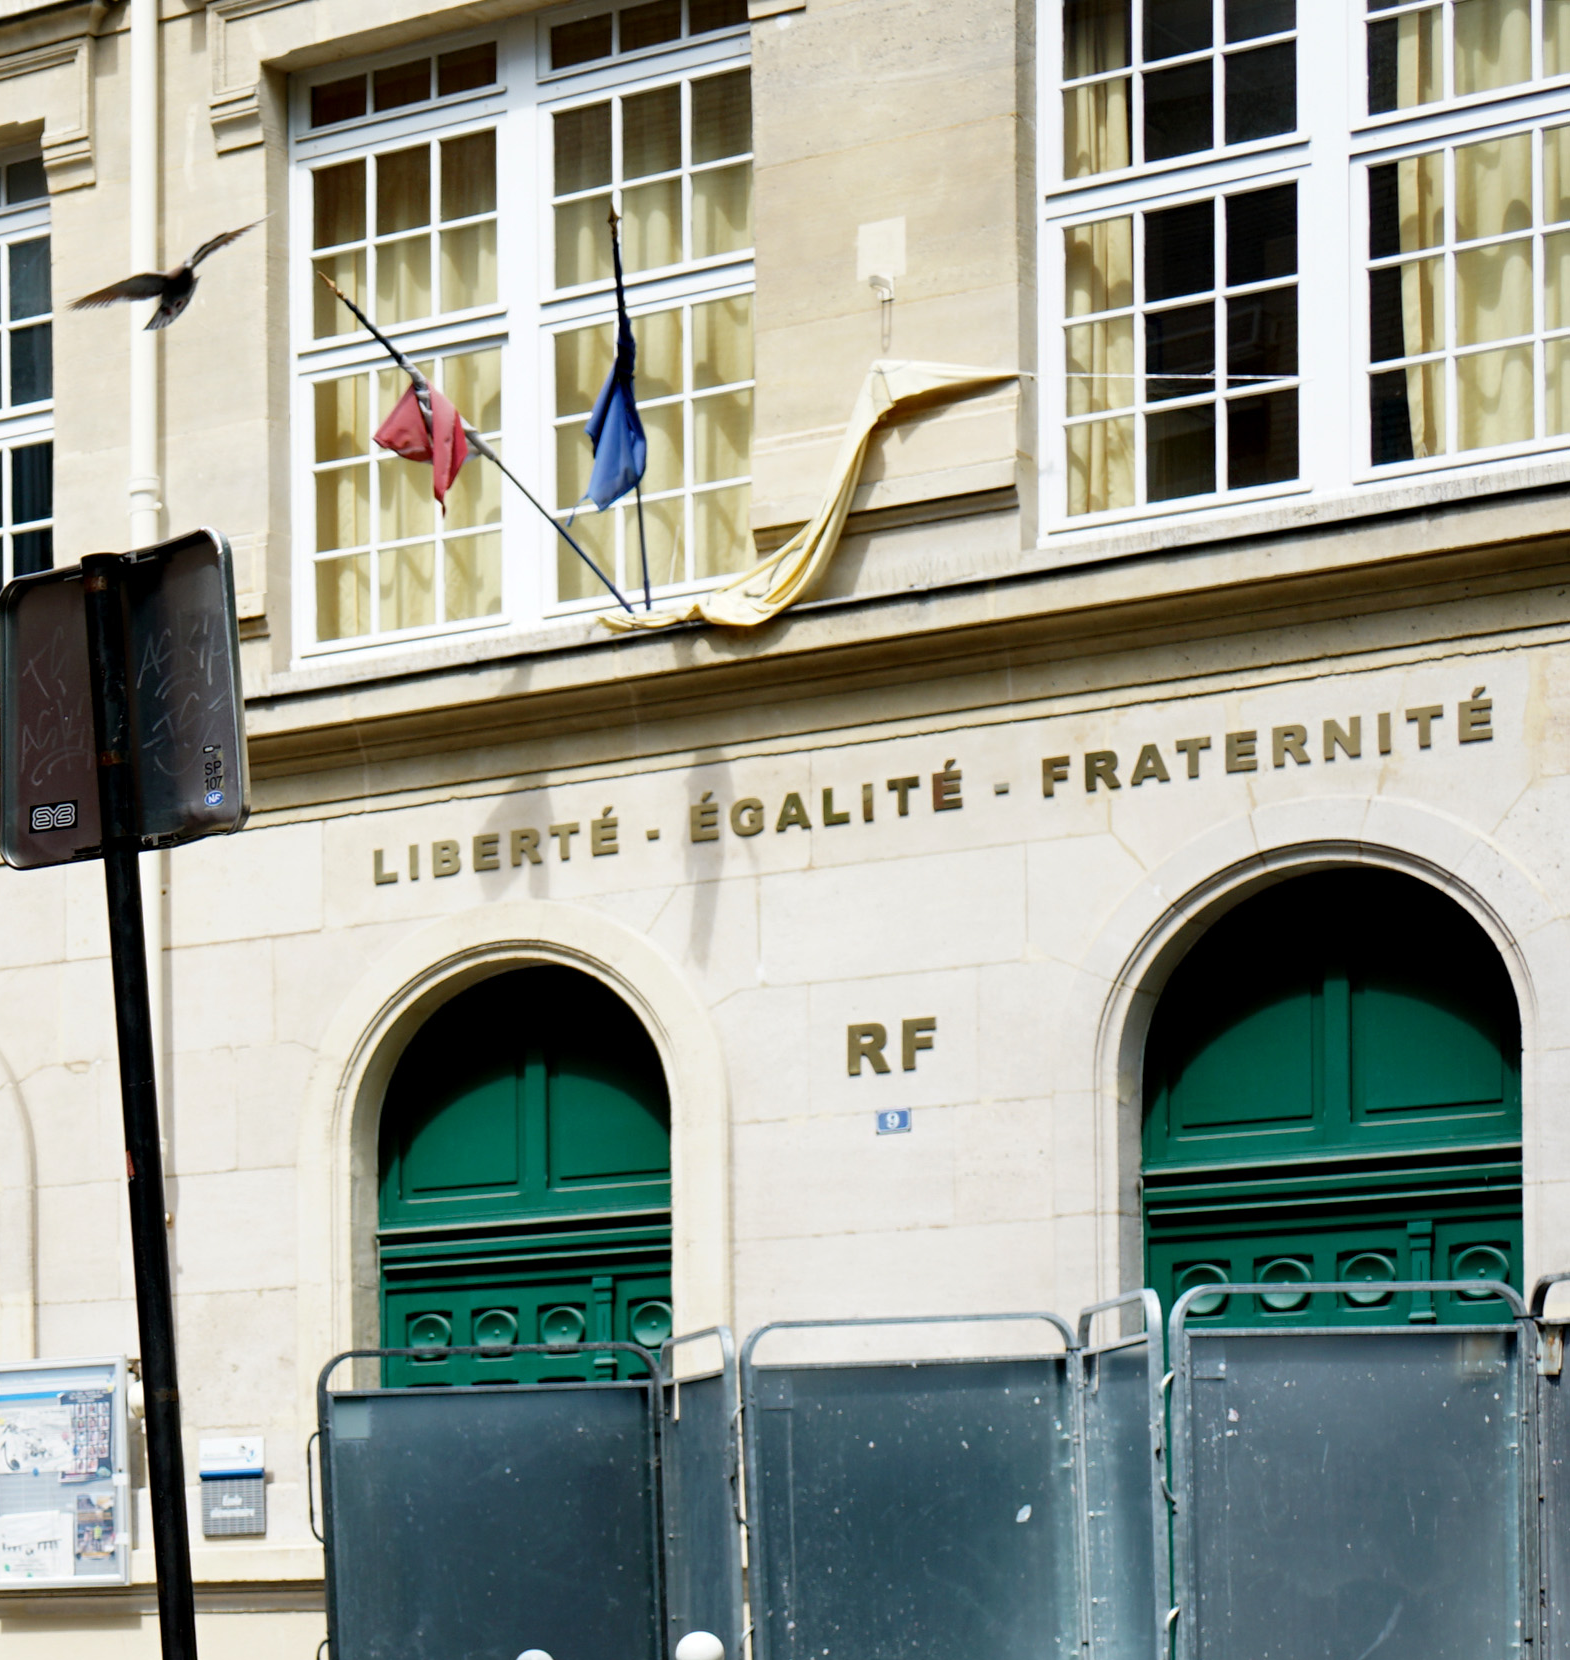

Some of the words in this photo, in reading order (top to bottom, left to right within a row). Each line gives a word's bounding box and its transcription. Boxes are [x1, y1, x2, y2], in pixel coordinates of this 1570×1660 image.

[204, 760, 222, 776] SP
[204, 775, 223, 791] 107
[373, 806, 619, 885] LIBERTÉ
[689, 758, 963, 844] ÉGALITÉ
[1041, 686, 1494, 798] FRATERNITÉ
[847, 1016, 937, 1077] RF
[886, 1110, 900, 1130] 9
